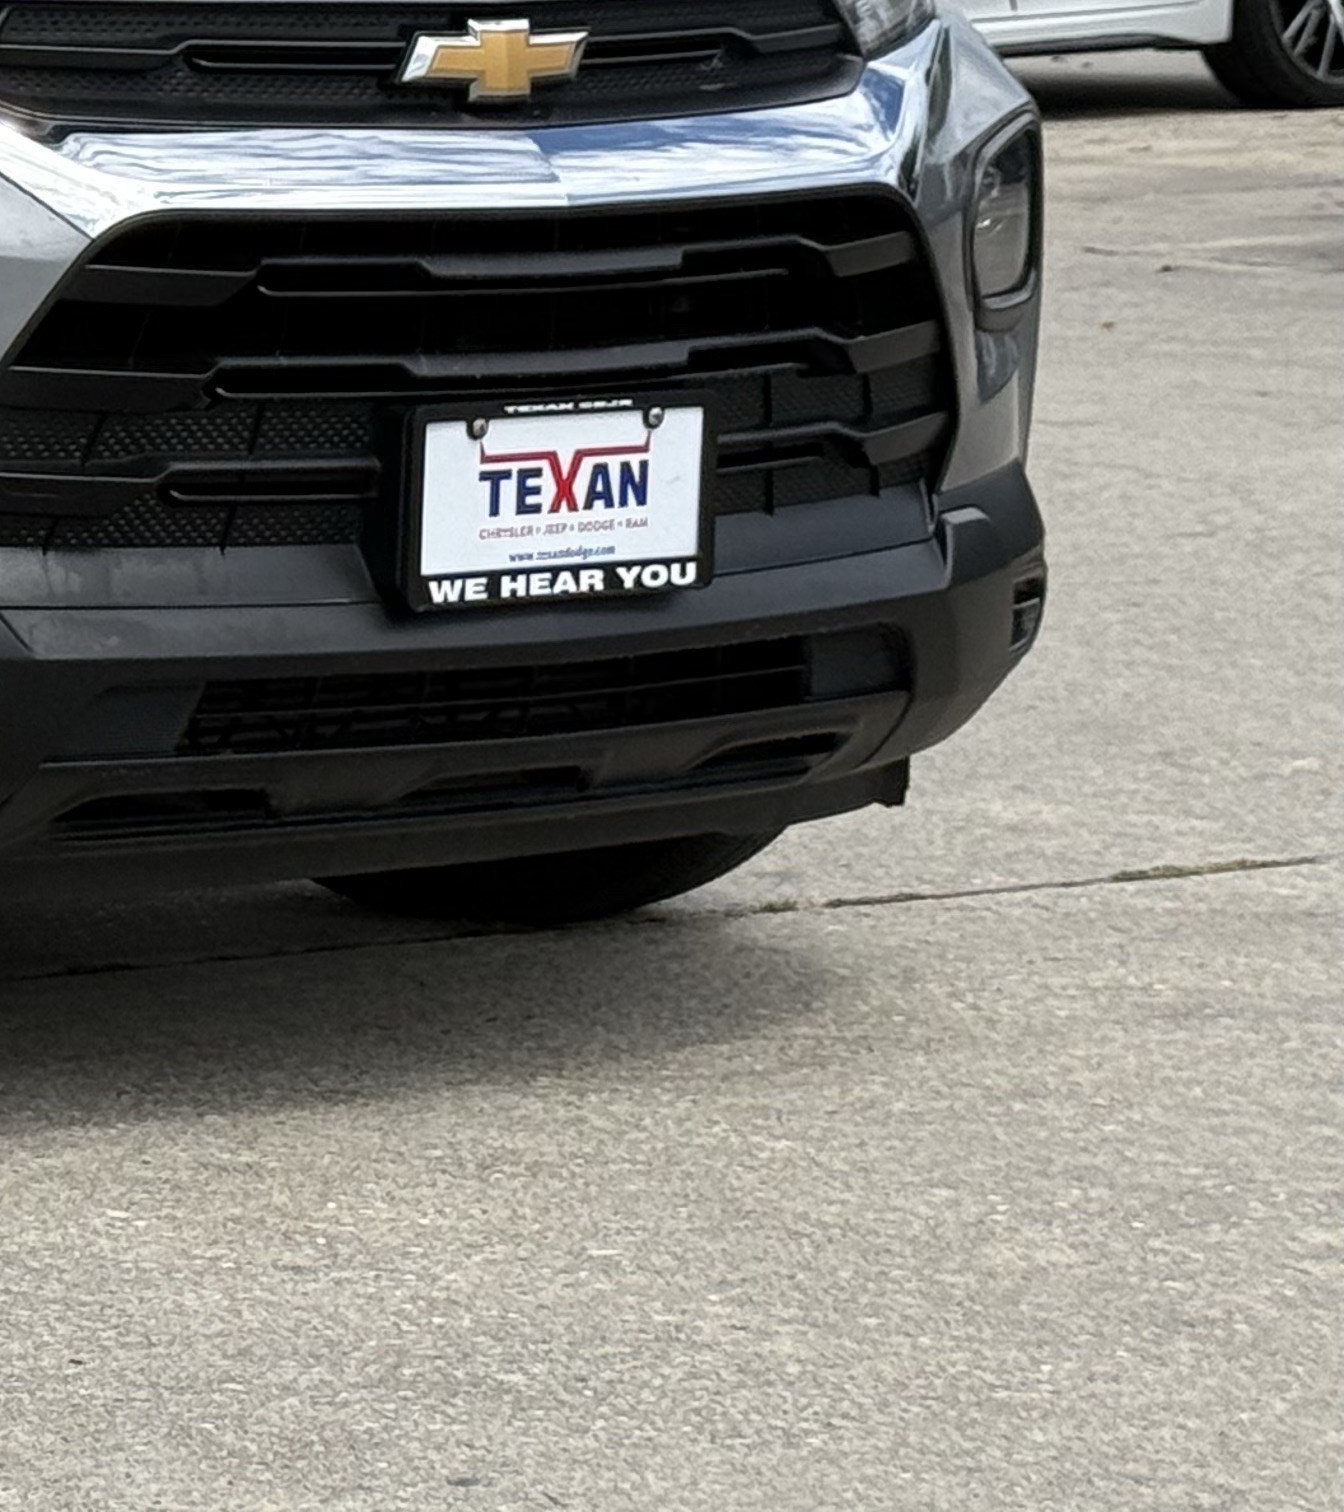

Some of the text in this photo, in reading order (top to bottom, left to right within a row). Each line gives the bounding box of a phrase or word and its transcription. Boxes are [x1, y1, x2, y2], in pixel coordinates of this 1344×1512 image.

[479, 448, 650, 517] TEXAN
[577, 519, 615, 533] DODGE
[428, 561, 698, 605] WE HEAR YOU
